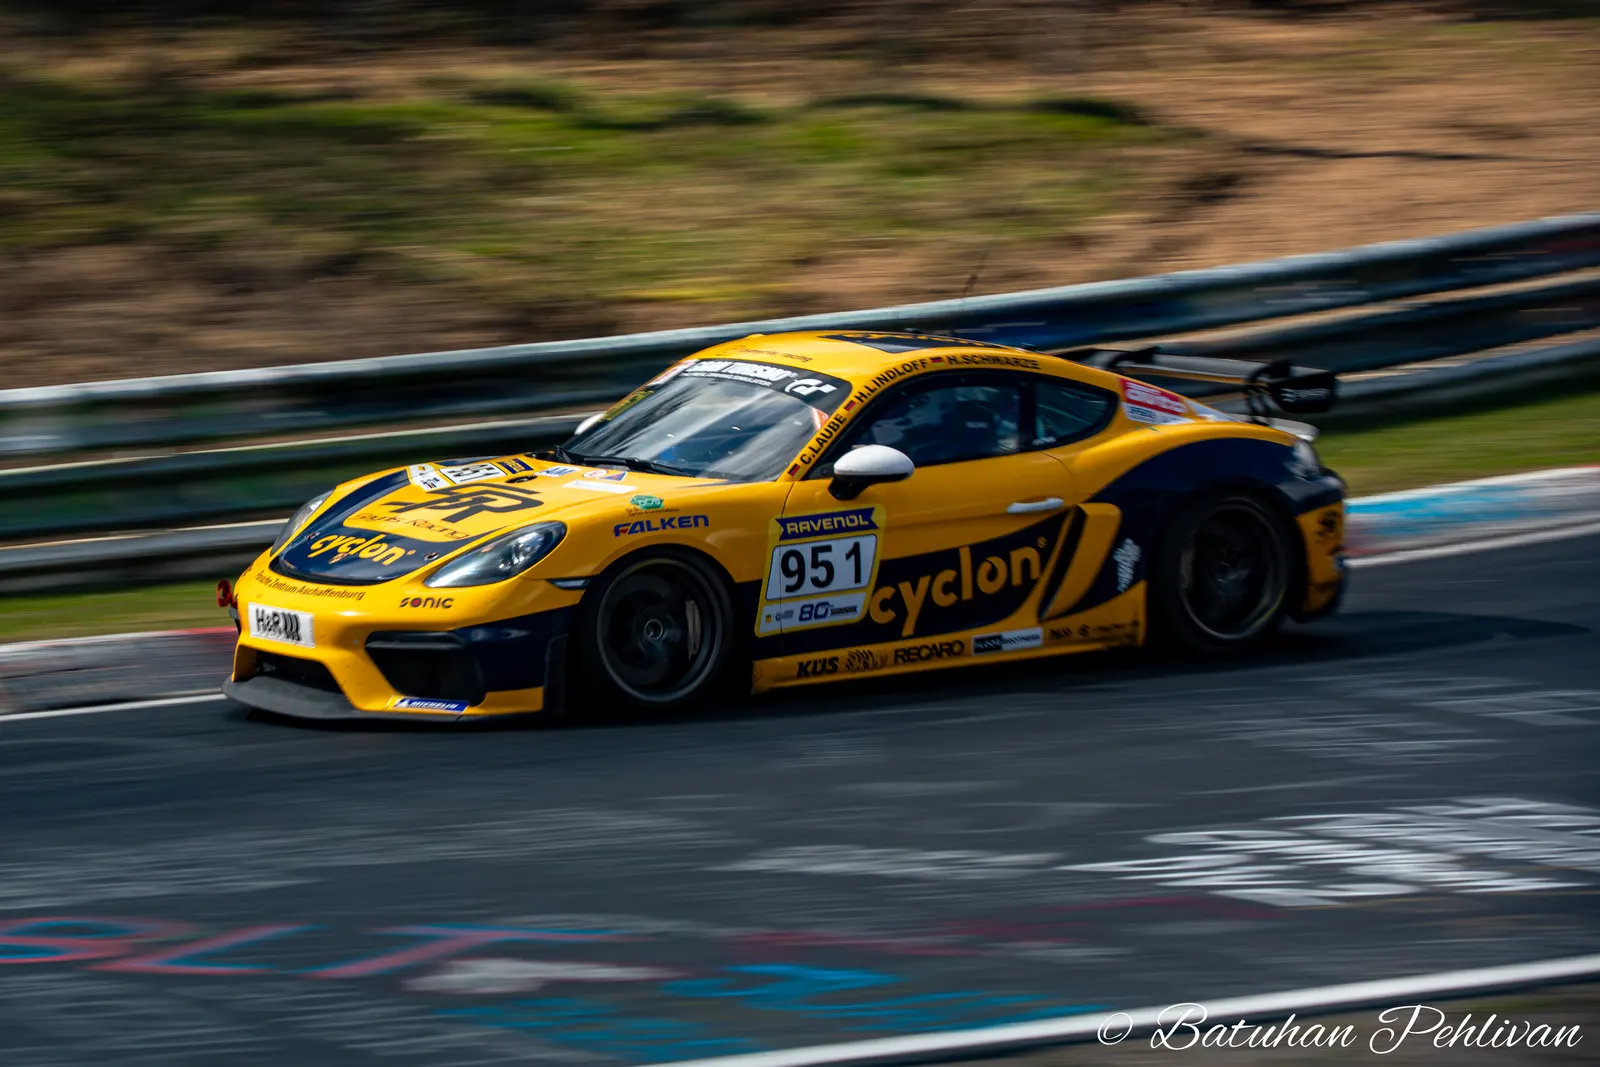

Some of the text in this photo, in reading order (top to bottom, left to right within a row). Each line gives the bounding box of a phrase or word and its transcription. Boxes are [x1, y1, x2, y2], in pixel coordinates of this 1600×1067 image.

[947, 354, 1042, 370] H.SCHWARZE
[855, 359, 930, 403] H.LINDLOFF
[800, 414, 848, 465] C.LAUBE
[613, 514, 710, 537] FALKEN
[786, 514, 869, 535] RAVENOL
[780, 541, 862, 593] 951
[269, 576, 297, 593] Zentrum
[297, 584, 366, 601] Aschaffenburg
[869, 545, 1042, 638] cyclon
[894, 640, 965, 664] RECARO
[796, 656, 839, 678] KÜS
